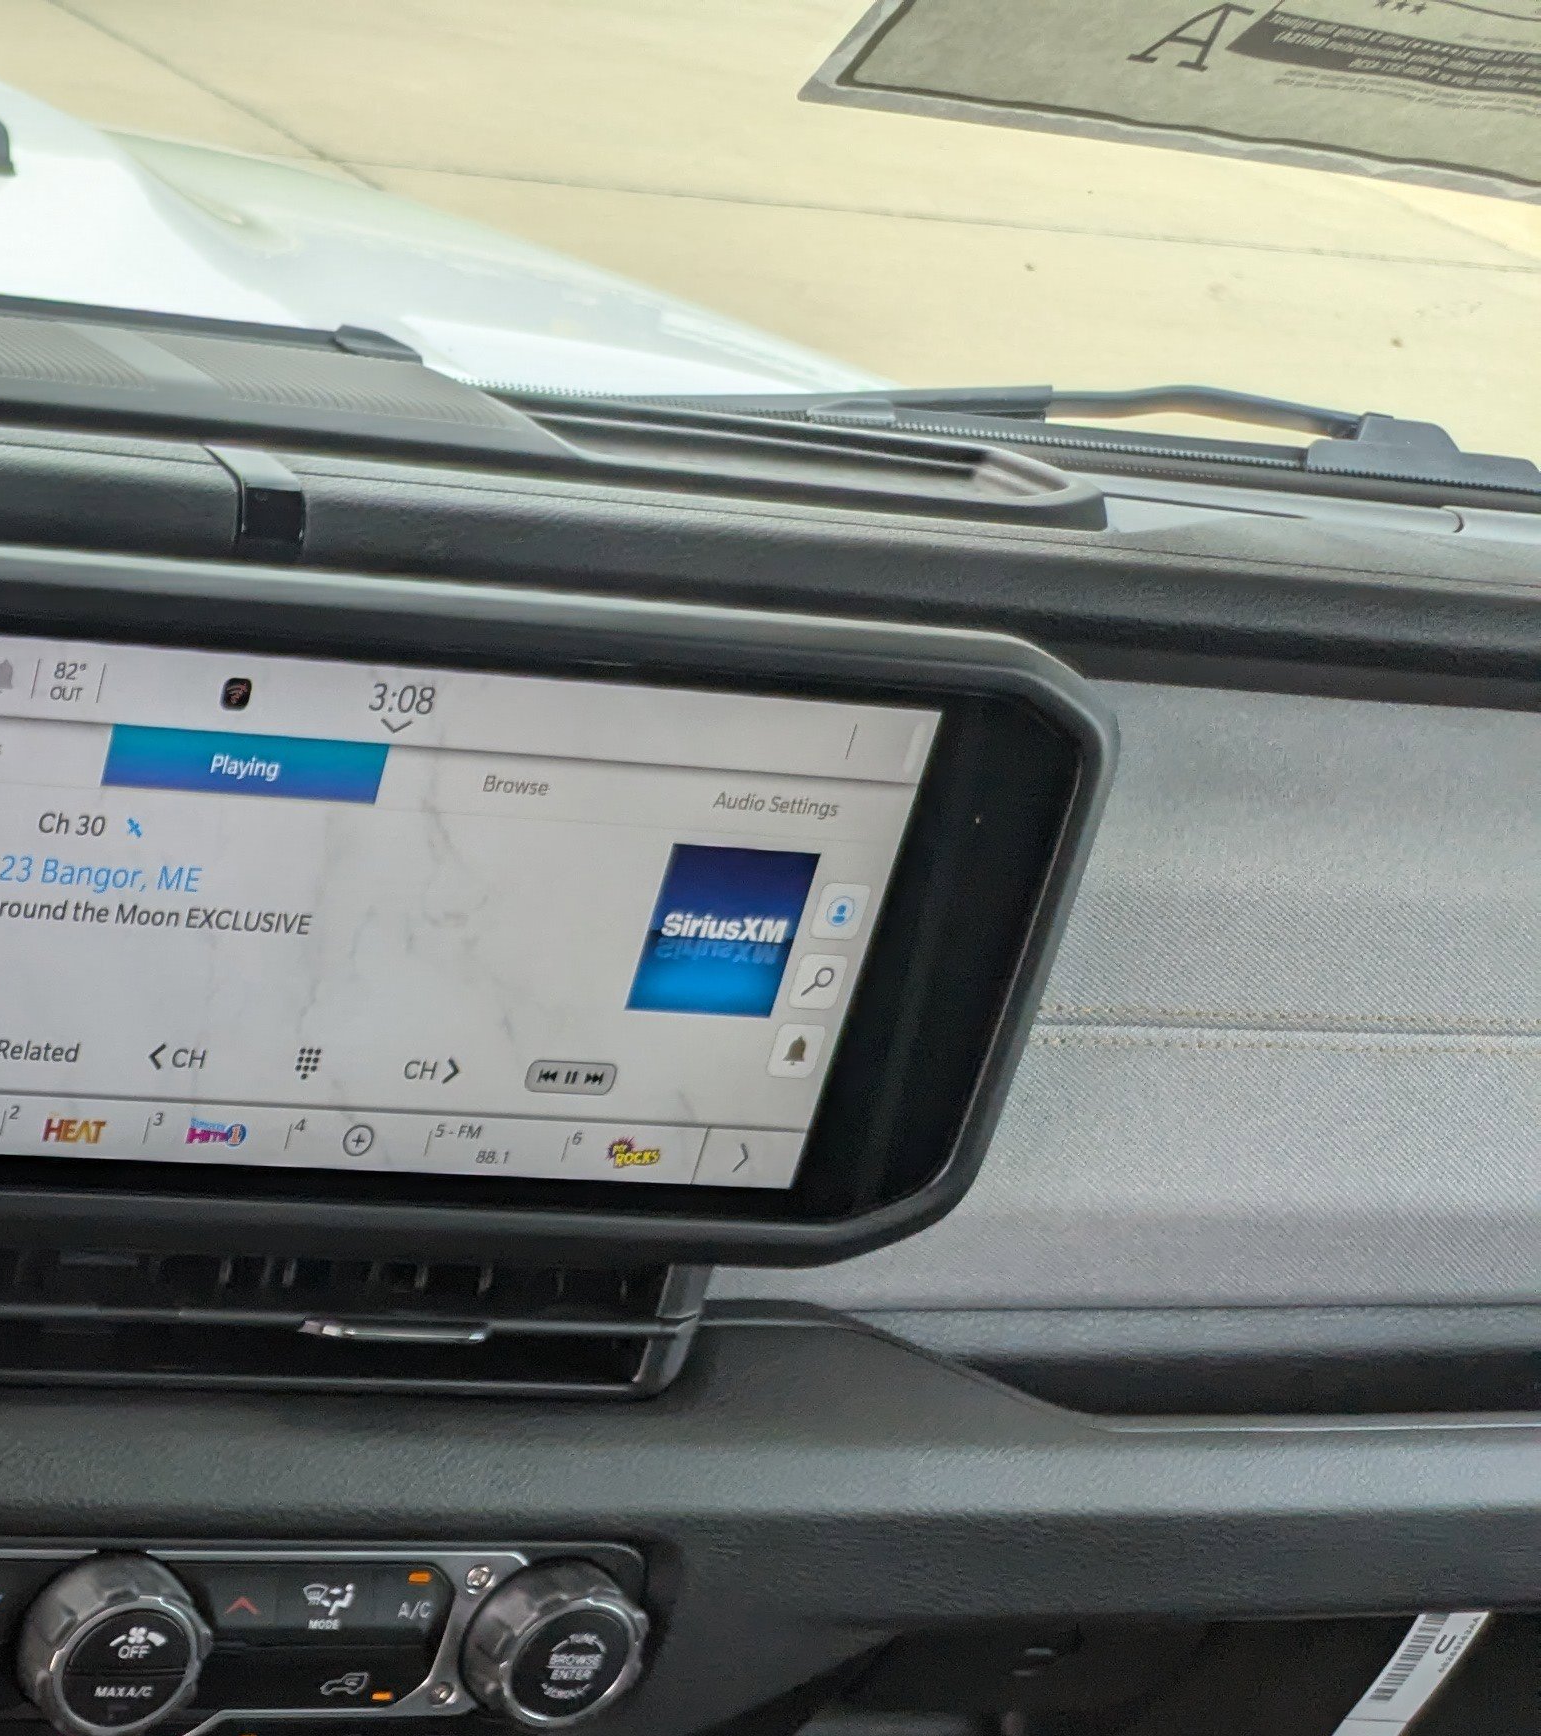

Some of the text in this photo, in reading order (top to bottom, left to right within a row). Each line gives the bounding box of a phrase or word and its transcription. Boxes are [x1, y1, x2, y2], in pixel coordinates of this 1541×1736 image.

[49, 686, 82, 703] OUT
[368, 682, 436, 717] 3:08
[210, 755, 279, 782] Playing
[482, 774, 549, 798] Browse
[714, 790, 839, 820] Audio Settings
[39, 813, 106, 838] Ch 30
[41, 858, 147, 896] Bangor,
[158, 866, 203, 892] ME
[73, 901, 109, 924] the
[115, 903, 178, 929] Moon
[186, 907, 312, 936] EXCLUSIVE
[661, 910, 789, 943] SiriusXM
[171, 1049, 206, 1069] CH
[404, 1059, 437, 1081] CH
[42, 1118, 106, 1144] HEAT
[475, 1150, 509, 1164] 88.1
[397, 1601, 432, 1622] A/C
[118, 1645, 150, 1658] OFF
